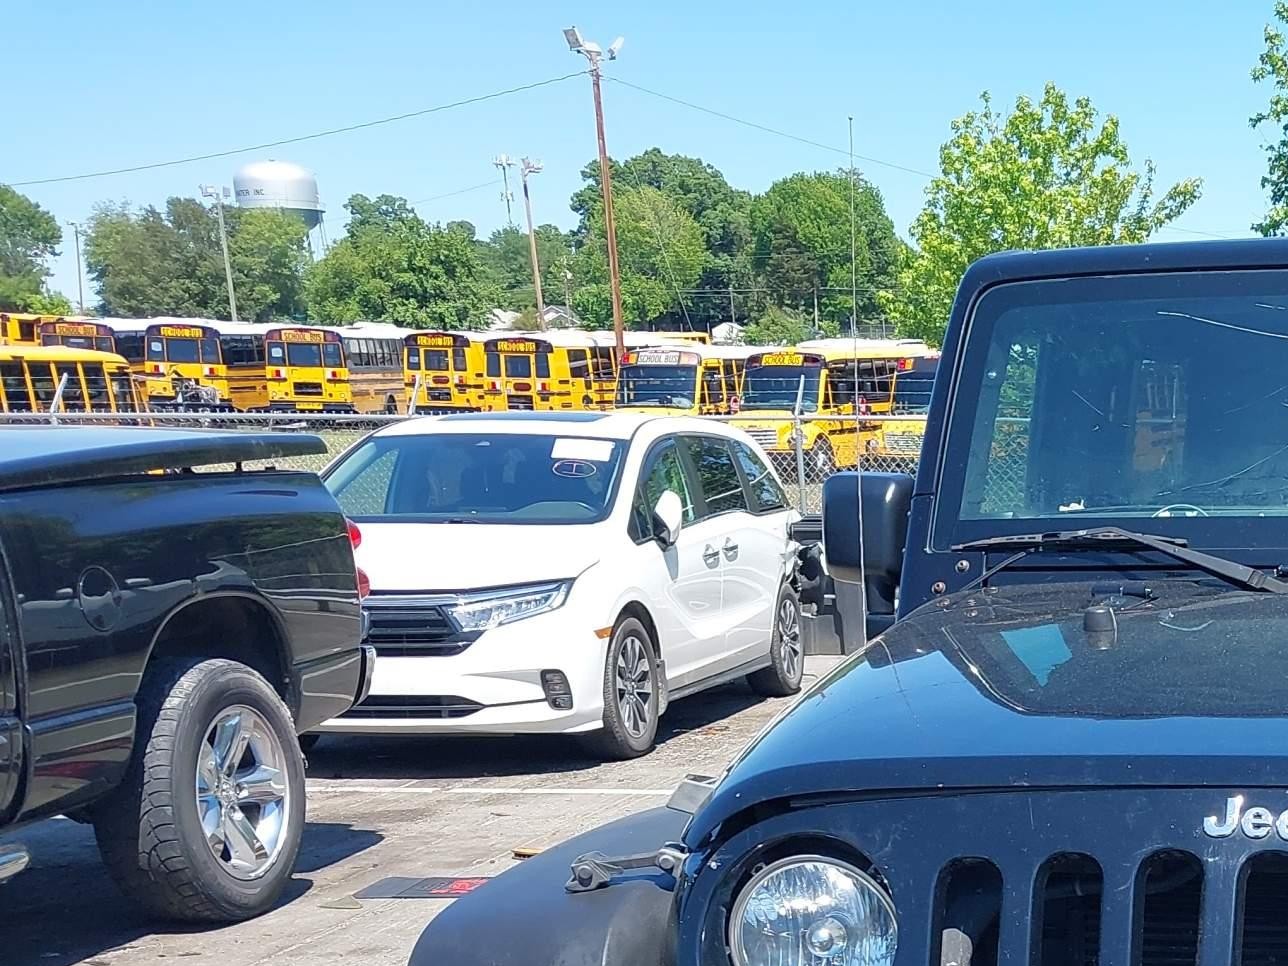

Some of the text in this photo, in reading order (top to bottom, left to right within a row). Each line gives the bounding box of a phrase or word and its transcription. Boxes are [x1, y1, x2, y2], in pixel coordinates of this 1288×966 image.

[284, 332, 322, 342] SCHOOL BUS
[639, 354, 678, 363] SCHOOL BUS
[764, 356, 800, 364] SCHOOL BUS
